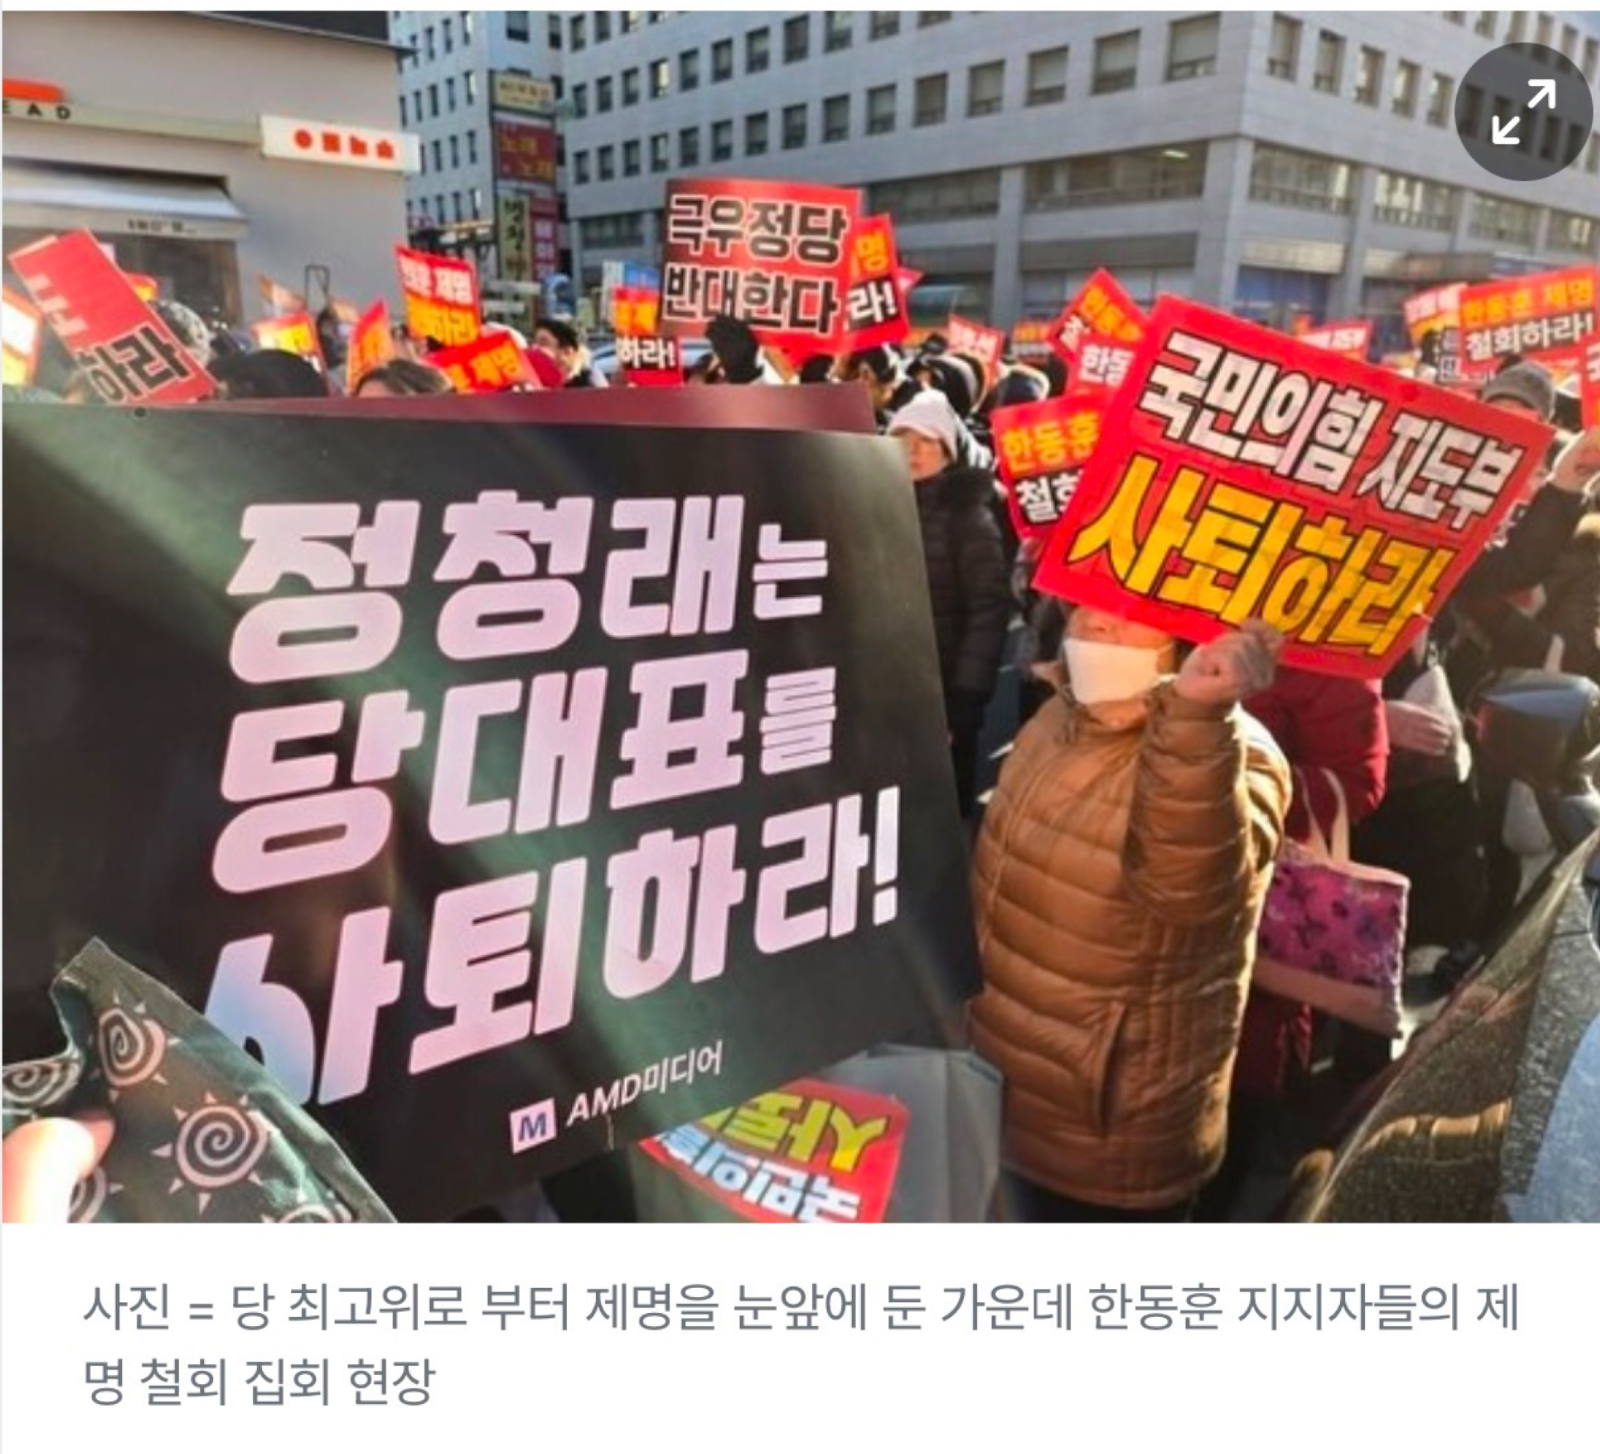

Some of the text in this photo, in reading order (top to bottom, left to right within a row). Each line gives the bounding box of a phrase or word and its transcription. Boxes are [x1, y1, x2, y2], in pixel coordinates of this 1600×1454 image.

[667, 195, 847, 267] 극우정당
[851, 230, 888, 279] 명
[663, 262, 840, 335] 반대한다
[1465, 311, 1594, 361] 철회하라!
[1001, 411, 1099, 472] 한동훈
[1138, 331, 1525, 531] 국민의힘 지도부
[226, 490, 828, 685] 정청래는
[1067, 455, 1454, 656] 사퇴하라
[211, 649, 837, 894] 당대표를
[203, 786, 900, 1105] 사퇴하라!
[517, 1039, 724, 1141] M AMD미디어
